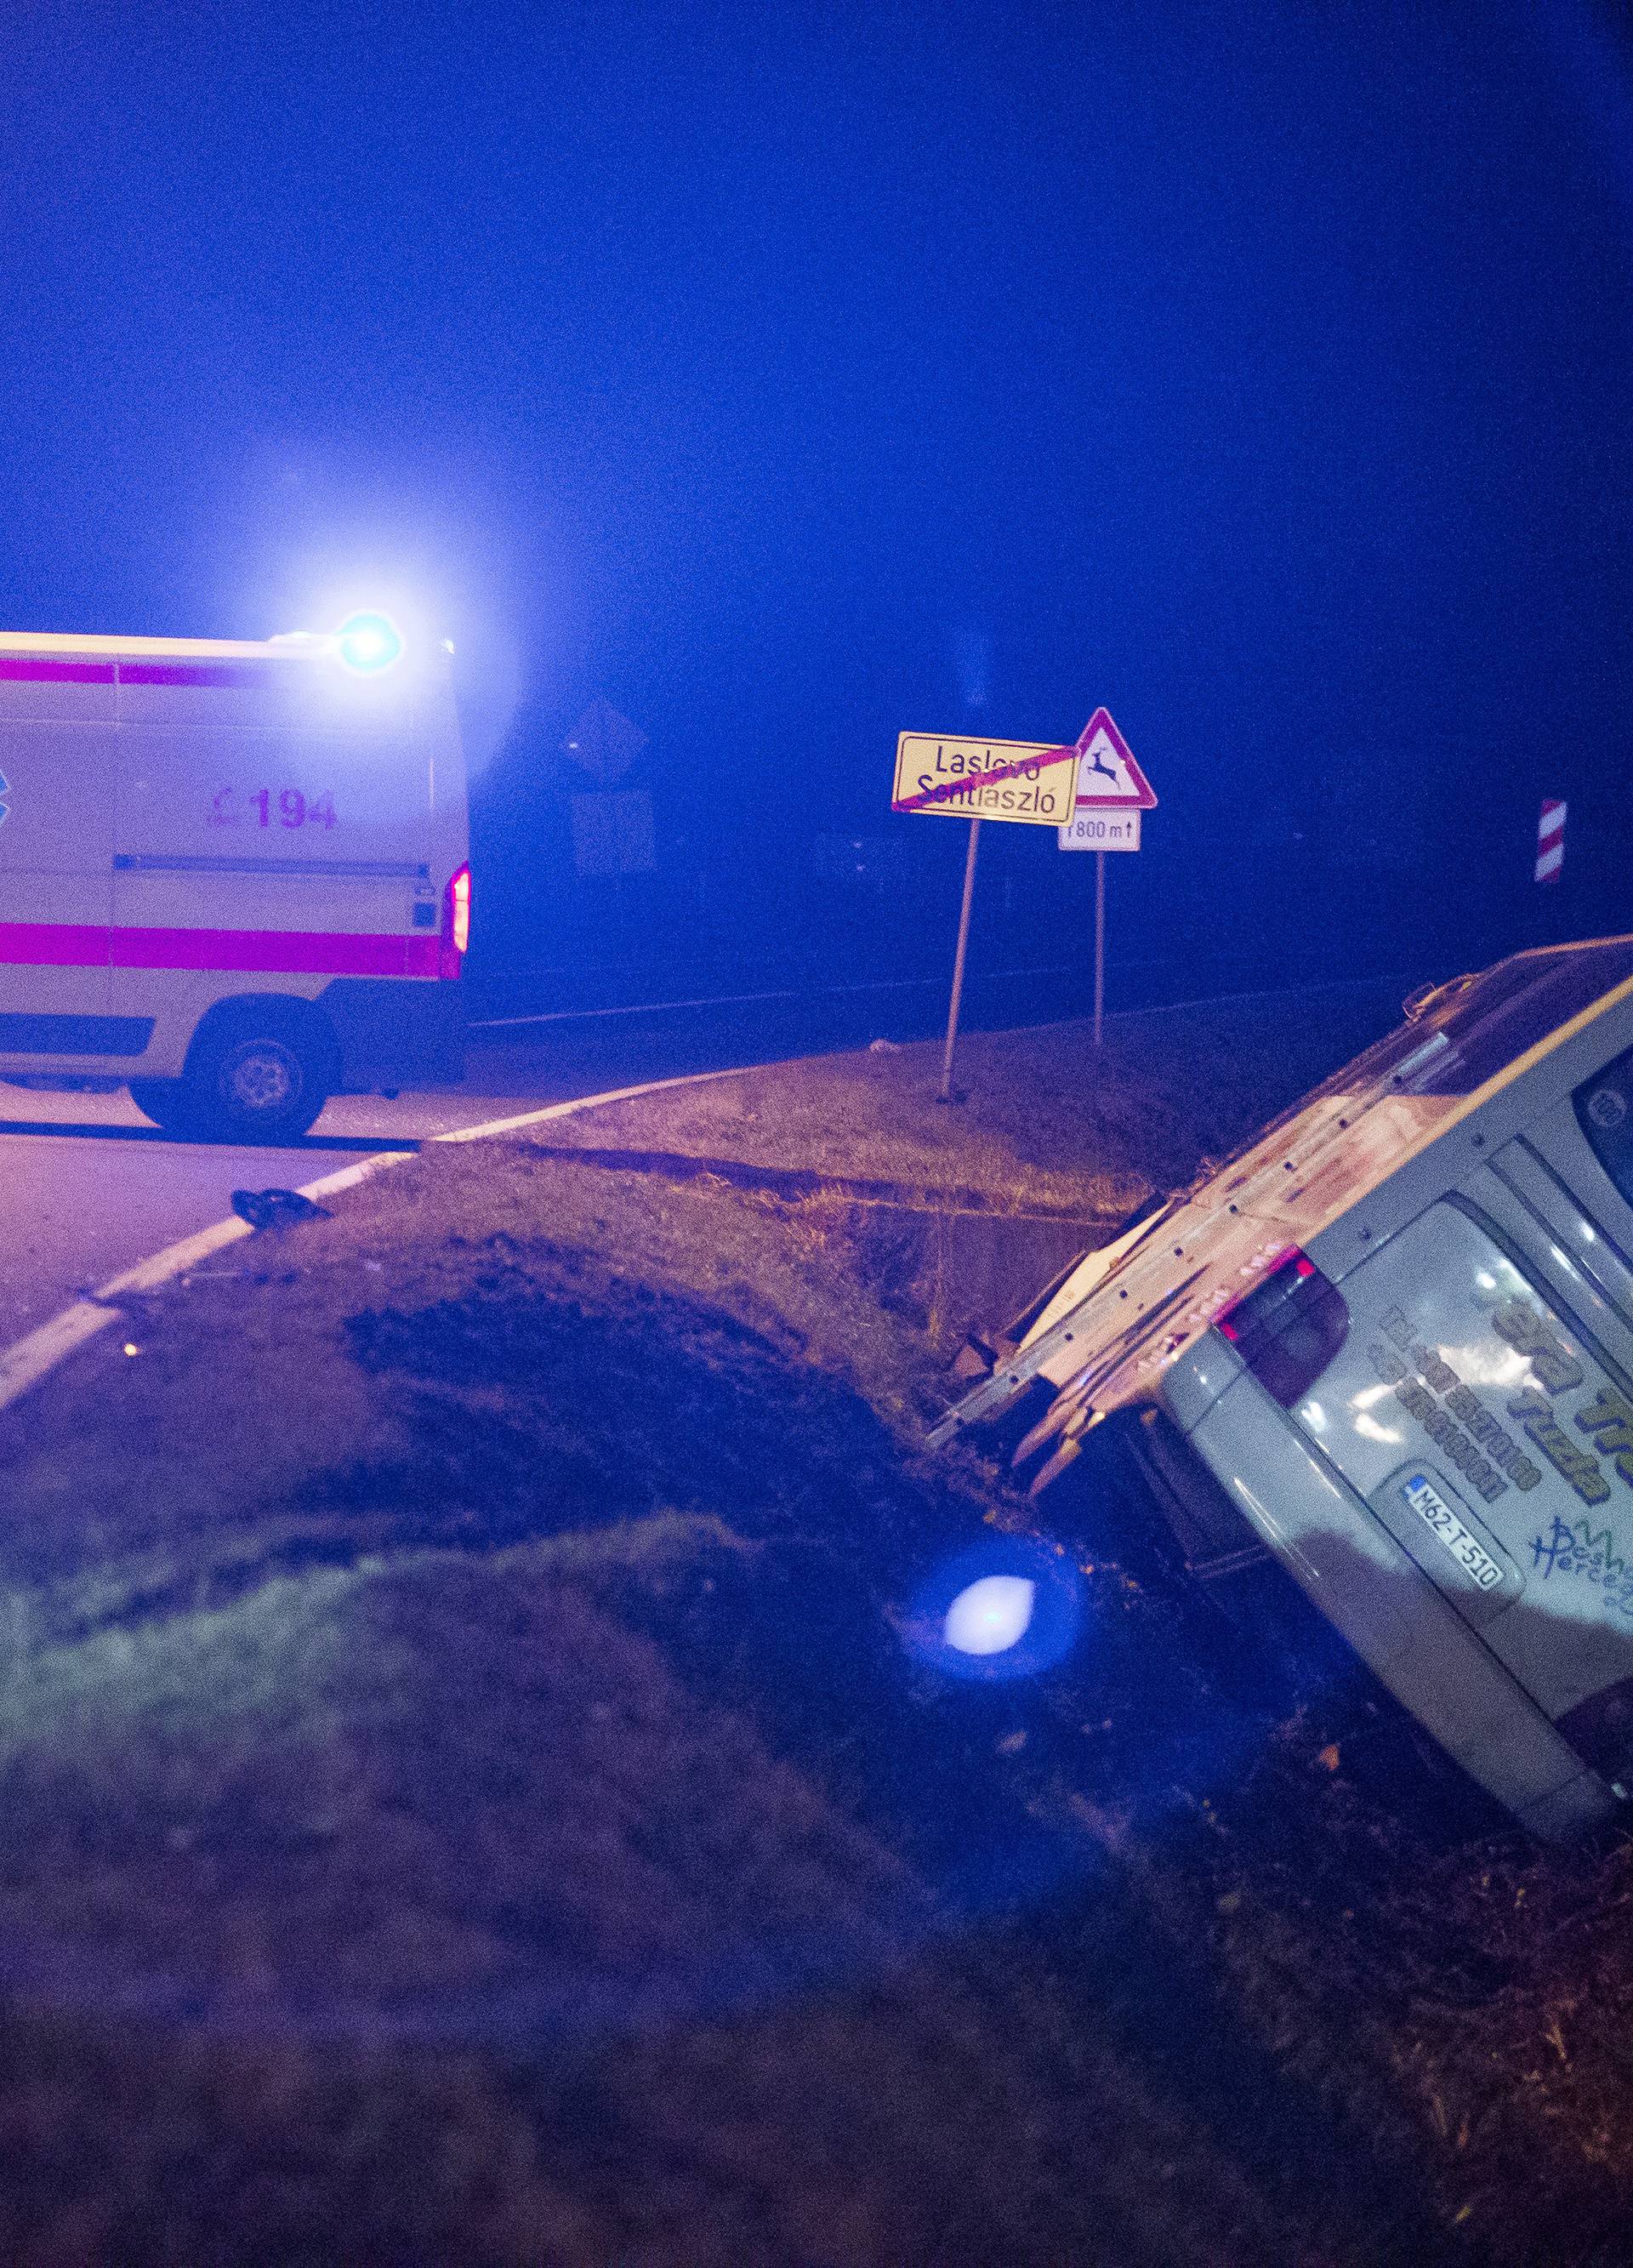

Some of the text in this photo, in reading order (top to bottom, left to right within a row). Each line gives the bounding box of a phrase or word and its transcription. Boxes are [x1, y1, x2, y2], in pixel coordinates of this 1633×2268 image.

[248, 788, 338, 830] 194
[1506, 1386, 1613, 1508] Tuzla
[1413, 1490, 1499, 1585] M62-T-510
